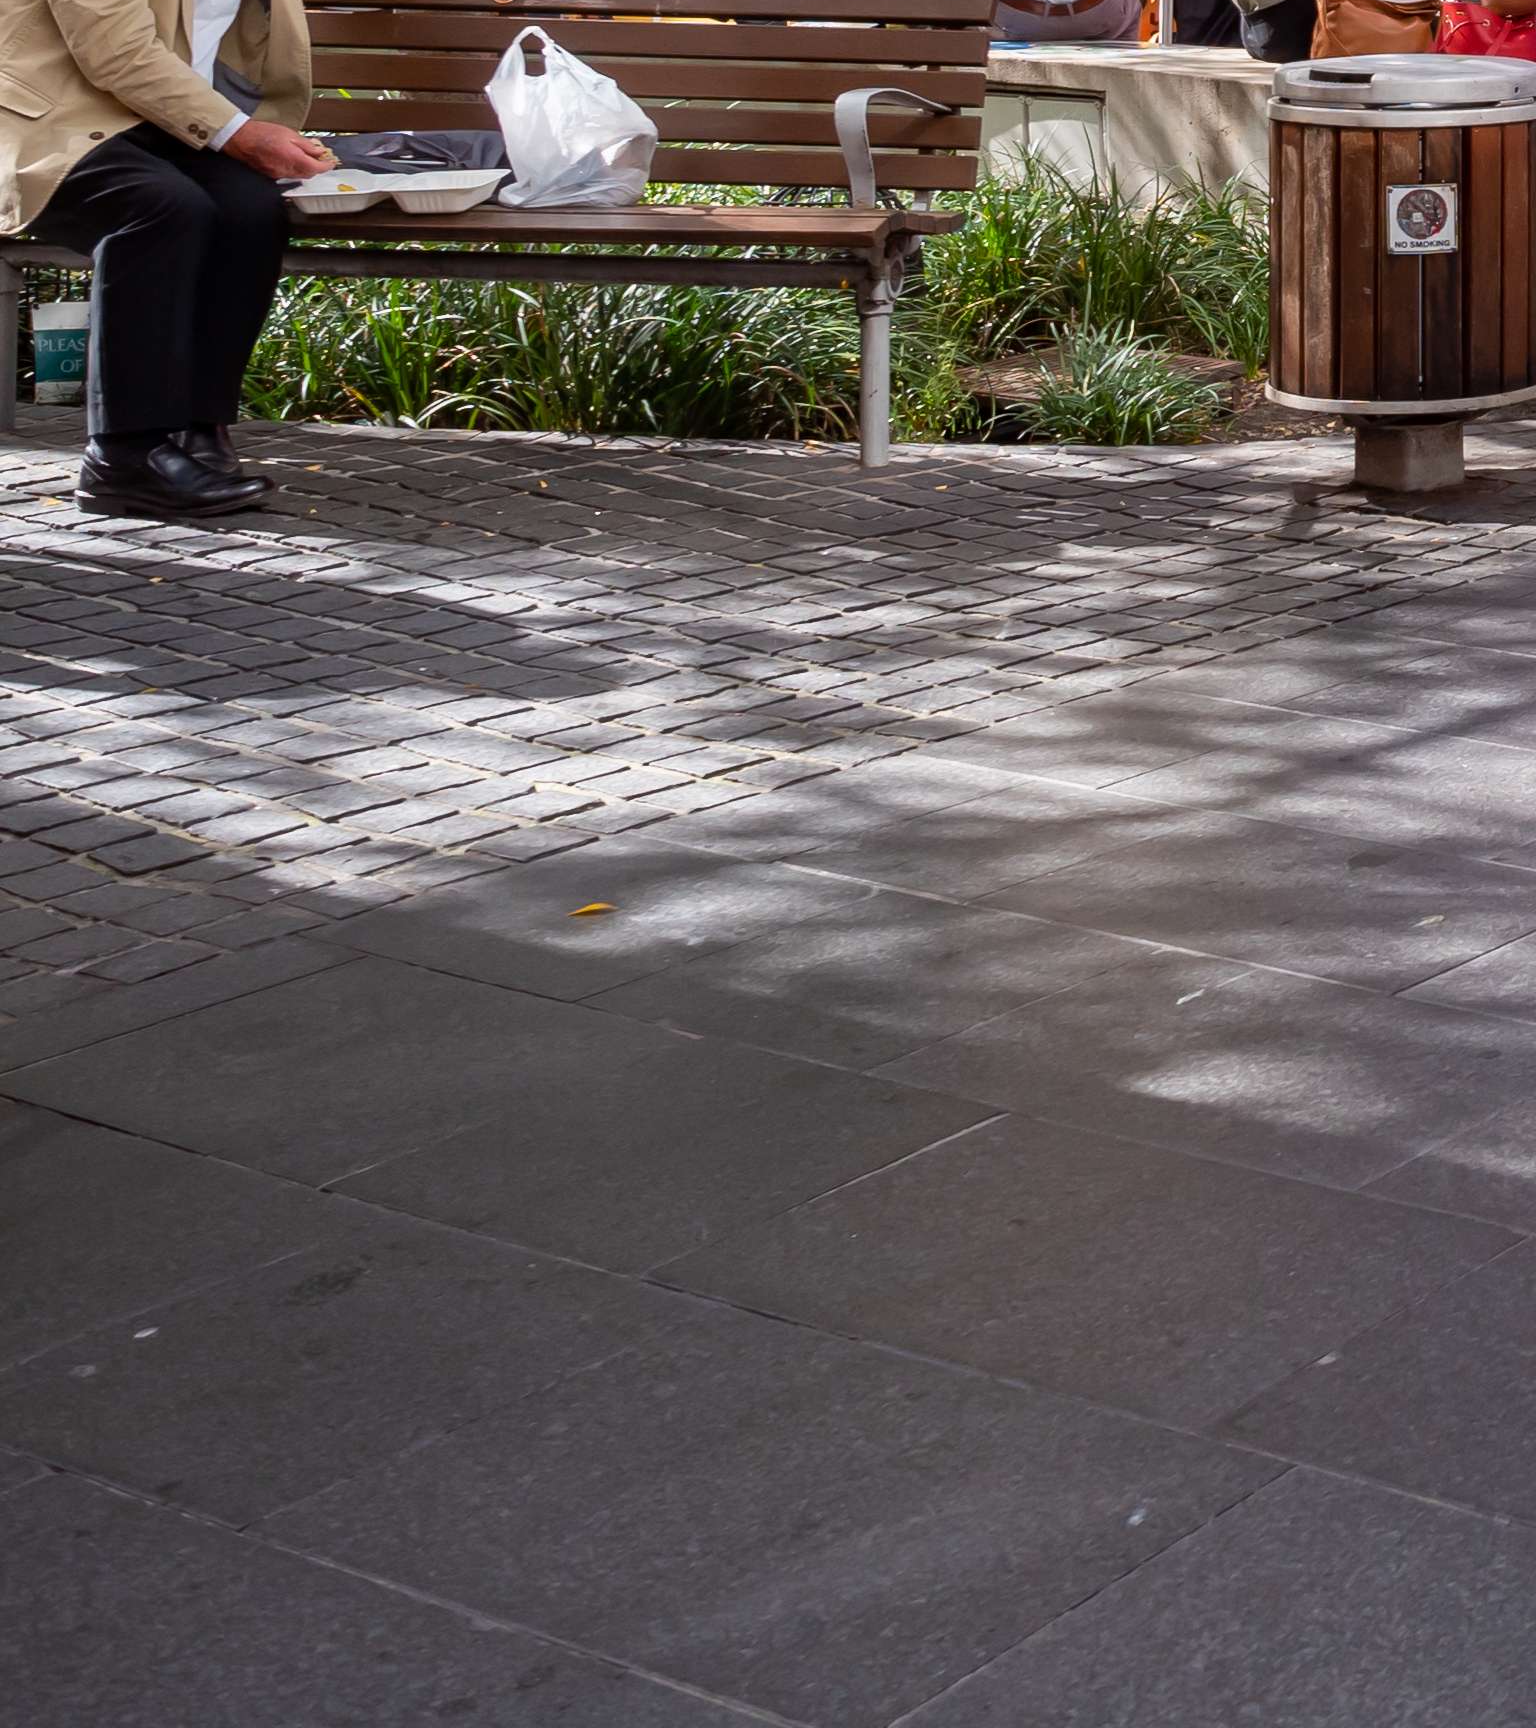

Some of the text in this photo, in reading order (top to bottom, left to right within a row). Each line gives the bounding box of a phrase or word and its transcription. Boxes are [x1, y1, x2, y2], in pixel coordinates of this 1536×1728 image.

[1394, 239, 1450, 249] NO SMOKING
[38, 337, 86, 353] PLEAS
